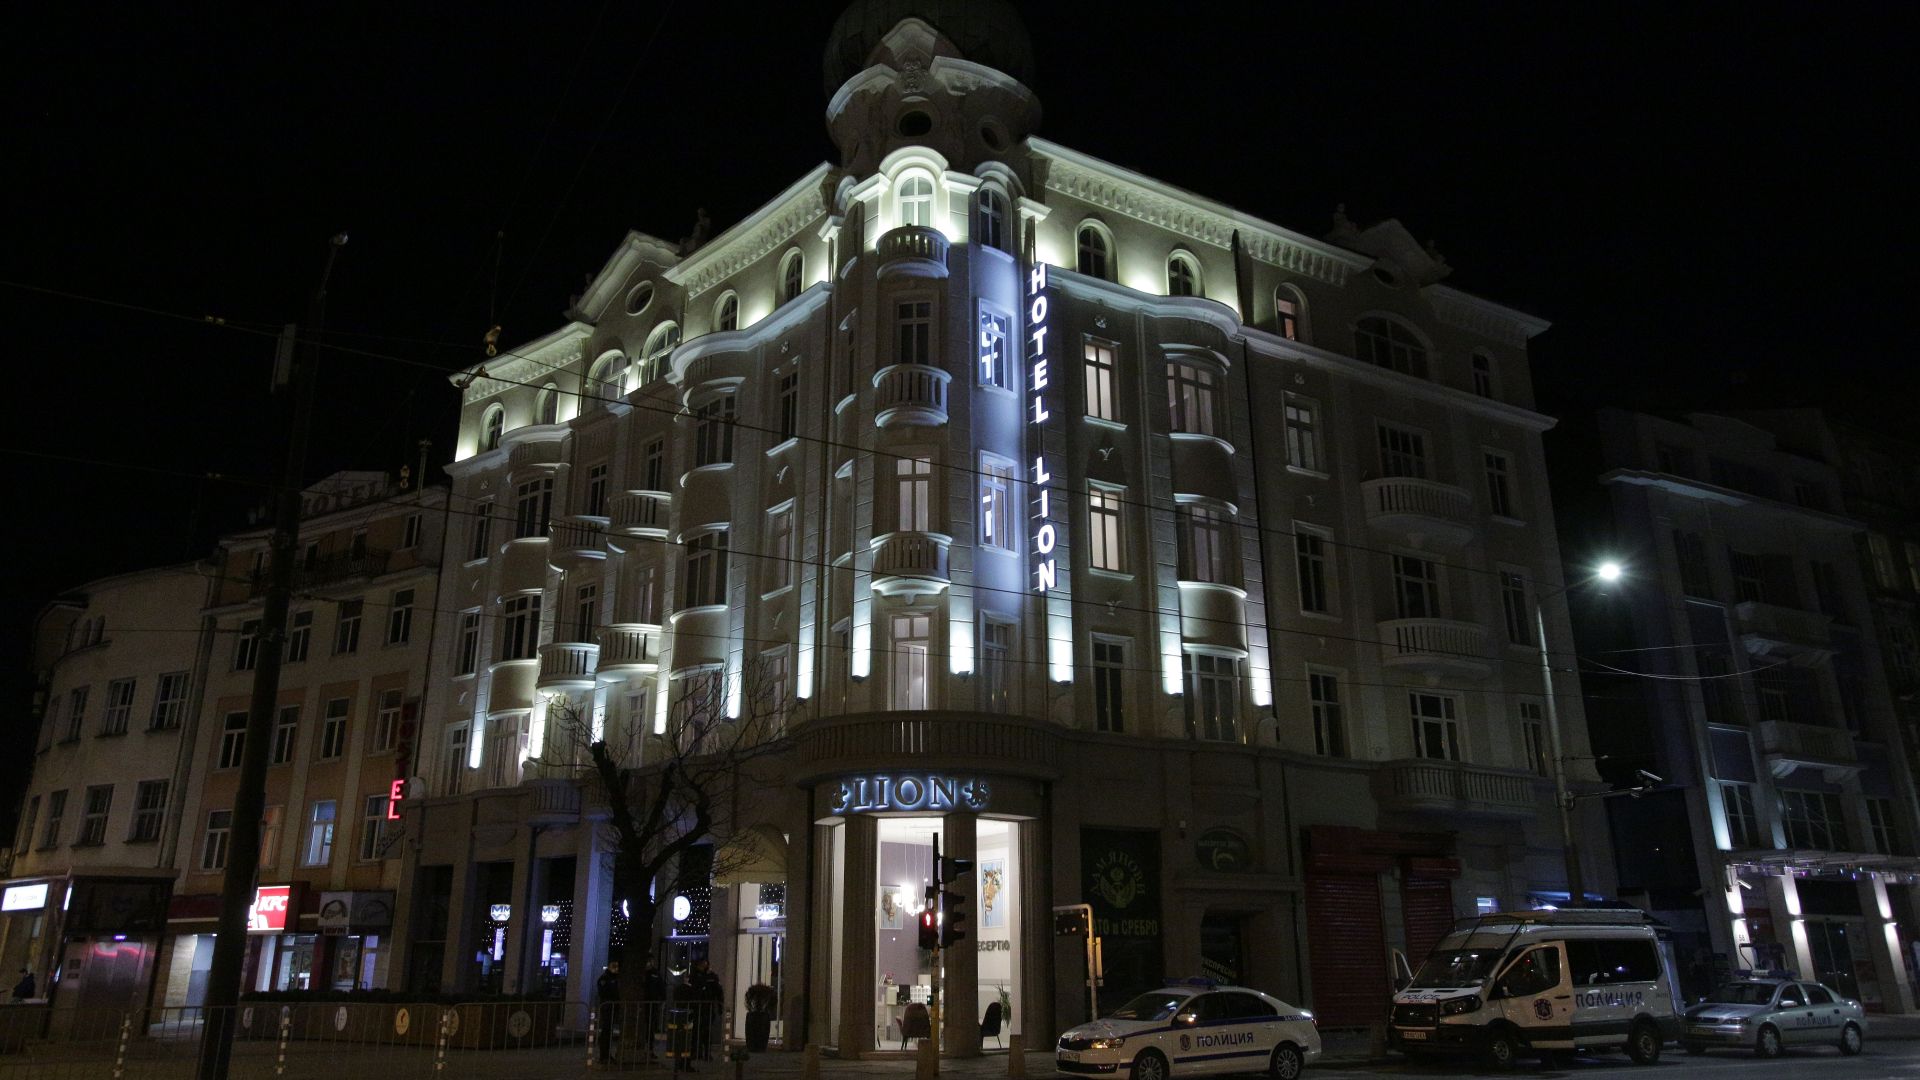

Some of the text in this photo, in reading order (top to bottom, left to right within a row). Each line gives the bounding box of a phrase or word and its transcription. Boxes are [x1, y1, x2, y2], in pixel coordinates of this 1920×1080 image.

[1031, 262, 1049, 424] HOTEL
[1036, 456, 1056, 592] LION
[853, 777, 957, 810] LION
[257, 895, 290, 911] KFC
[977, 940, 1010, 951] ECEPTIO
[1576, 992, 1642, 1008] ПОЛИЦИЯ
[1196, 1032, 1254, 1048] ПОЛИЦИЯ
